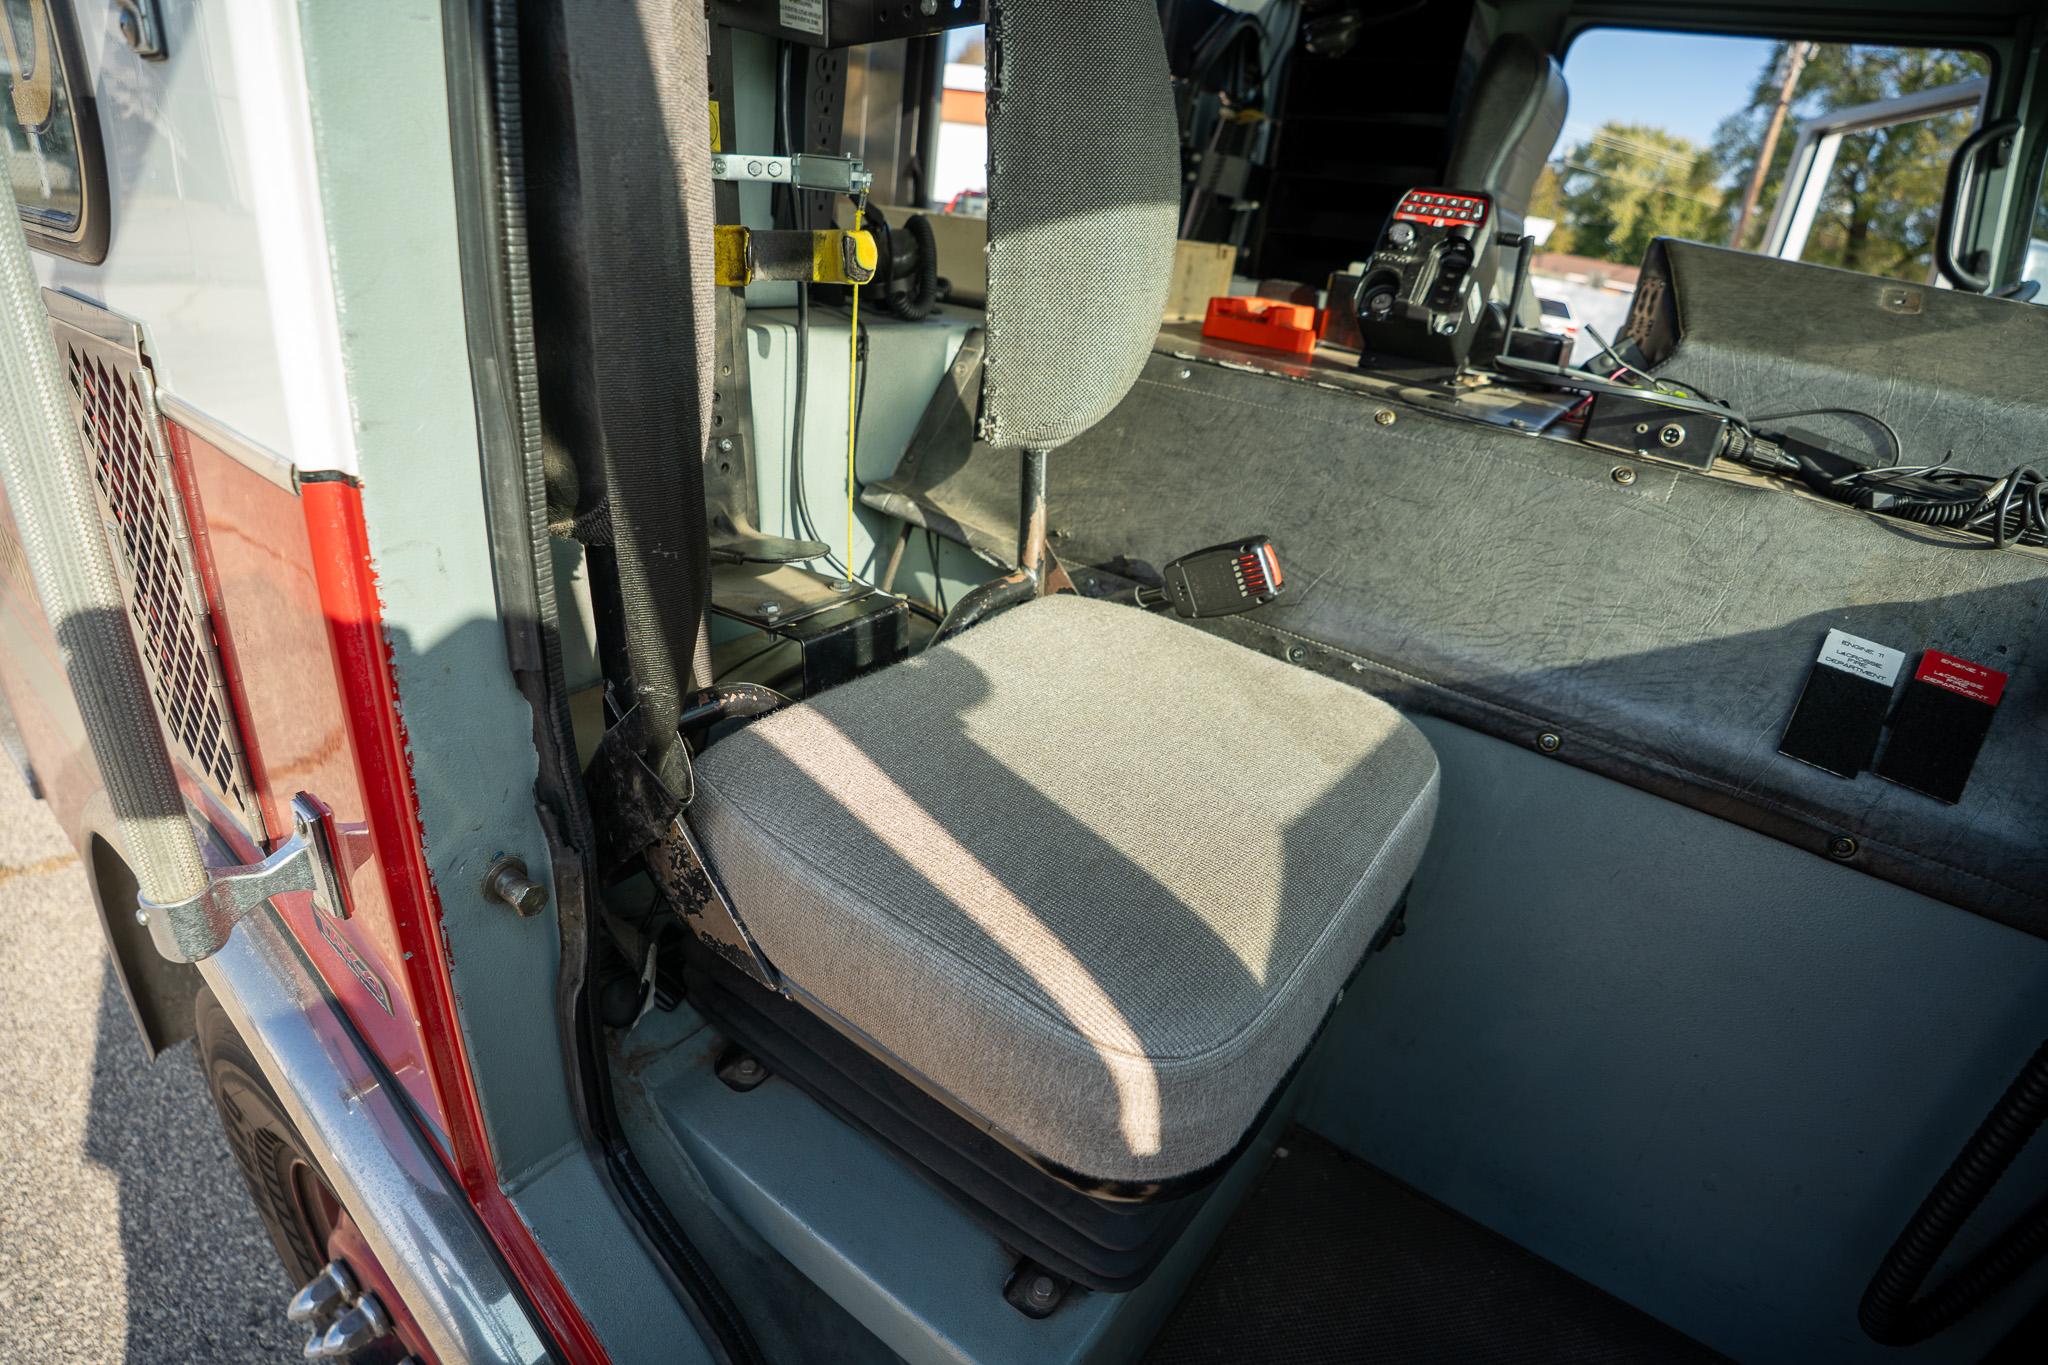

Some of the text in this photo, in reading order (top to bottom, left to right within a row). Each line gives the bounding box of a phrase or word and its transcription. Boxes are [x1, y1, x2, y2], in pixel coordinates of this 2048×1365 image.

[1841, 640, 1874, 655] ENGINE
[1836, 649, 1883, 669] LACROSSE
[1847, 658, 1868, 669] FIRE
[1941, 658, 1977, 674] ENGINE
[1825, 657, 1887, 681] DEPARTMENT
[1923, 675, 1989, 700] DEPARTMENT
[1946, 678, 1968, 689] FIRE
